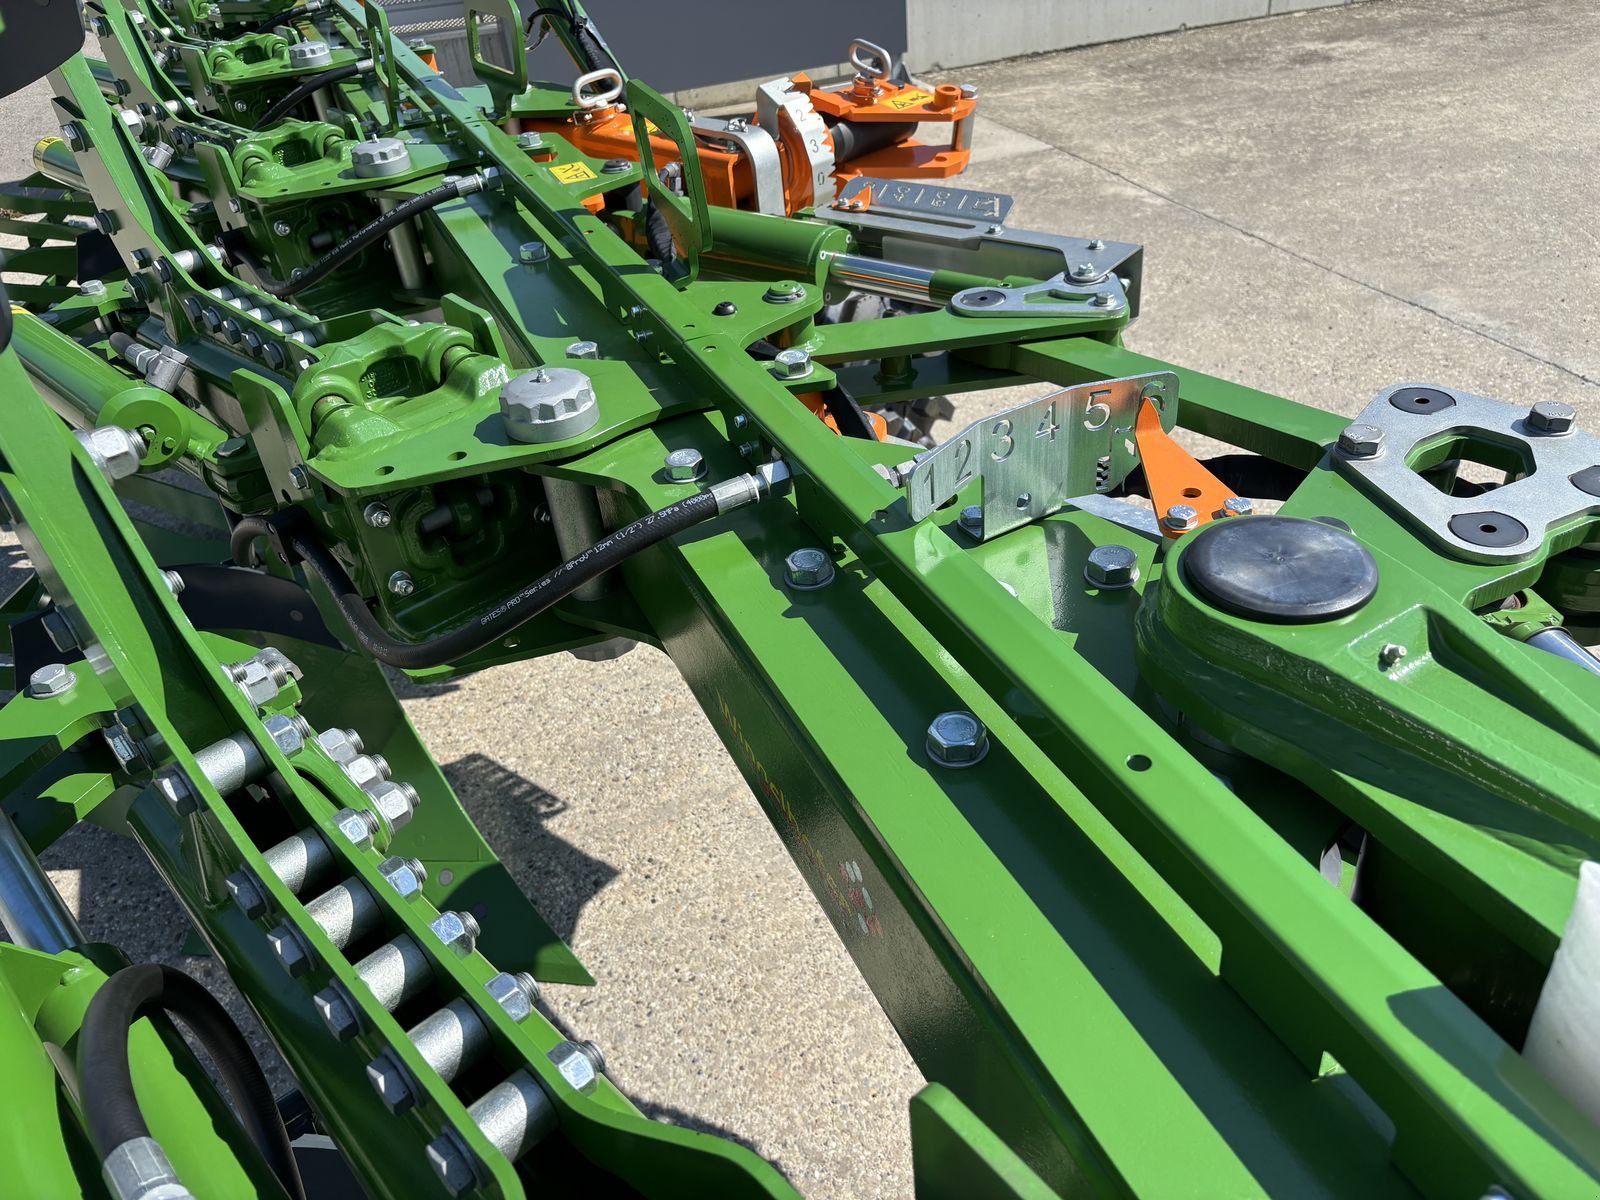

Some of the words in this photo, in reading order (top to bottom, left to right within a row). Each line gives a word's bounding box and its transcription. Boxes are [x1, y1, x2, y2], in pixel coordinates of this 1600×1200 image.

[795, 108, 807, 122] 2
[810, 138, 819, 153] 3
[817, 171, 825, 186] 0
[923, 463, 935, 506] 1
[954, 439, 972, 489] 2
[990, 419, 1015, 463] 3
[1034, 400, 1060, 442] 4
[1083, 389, 1112, 432] 5
